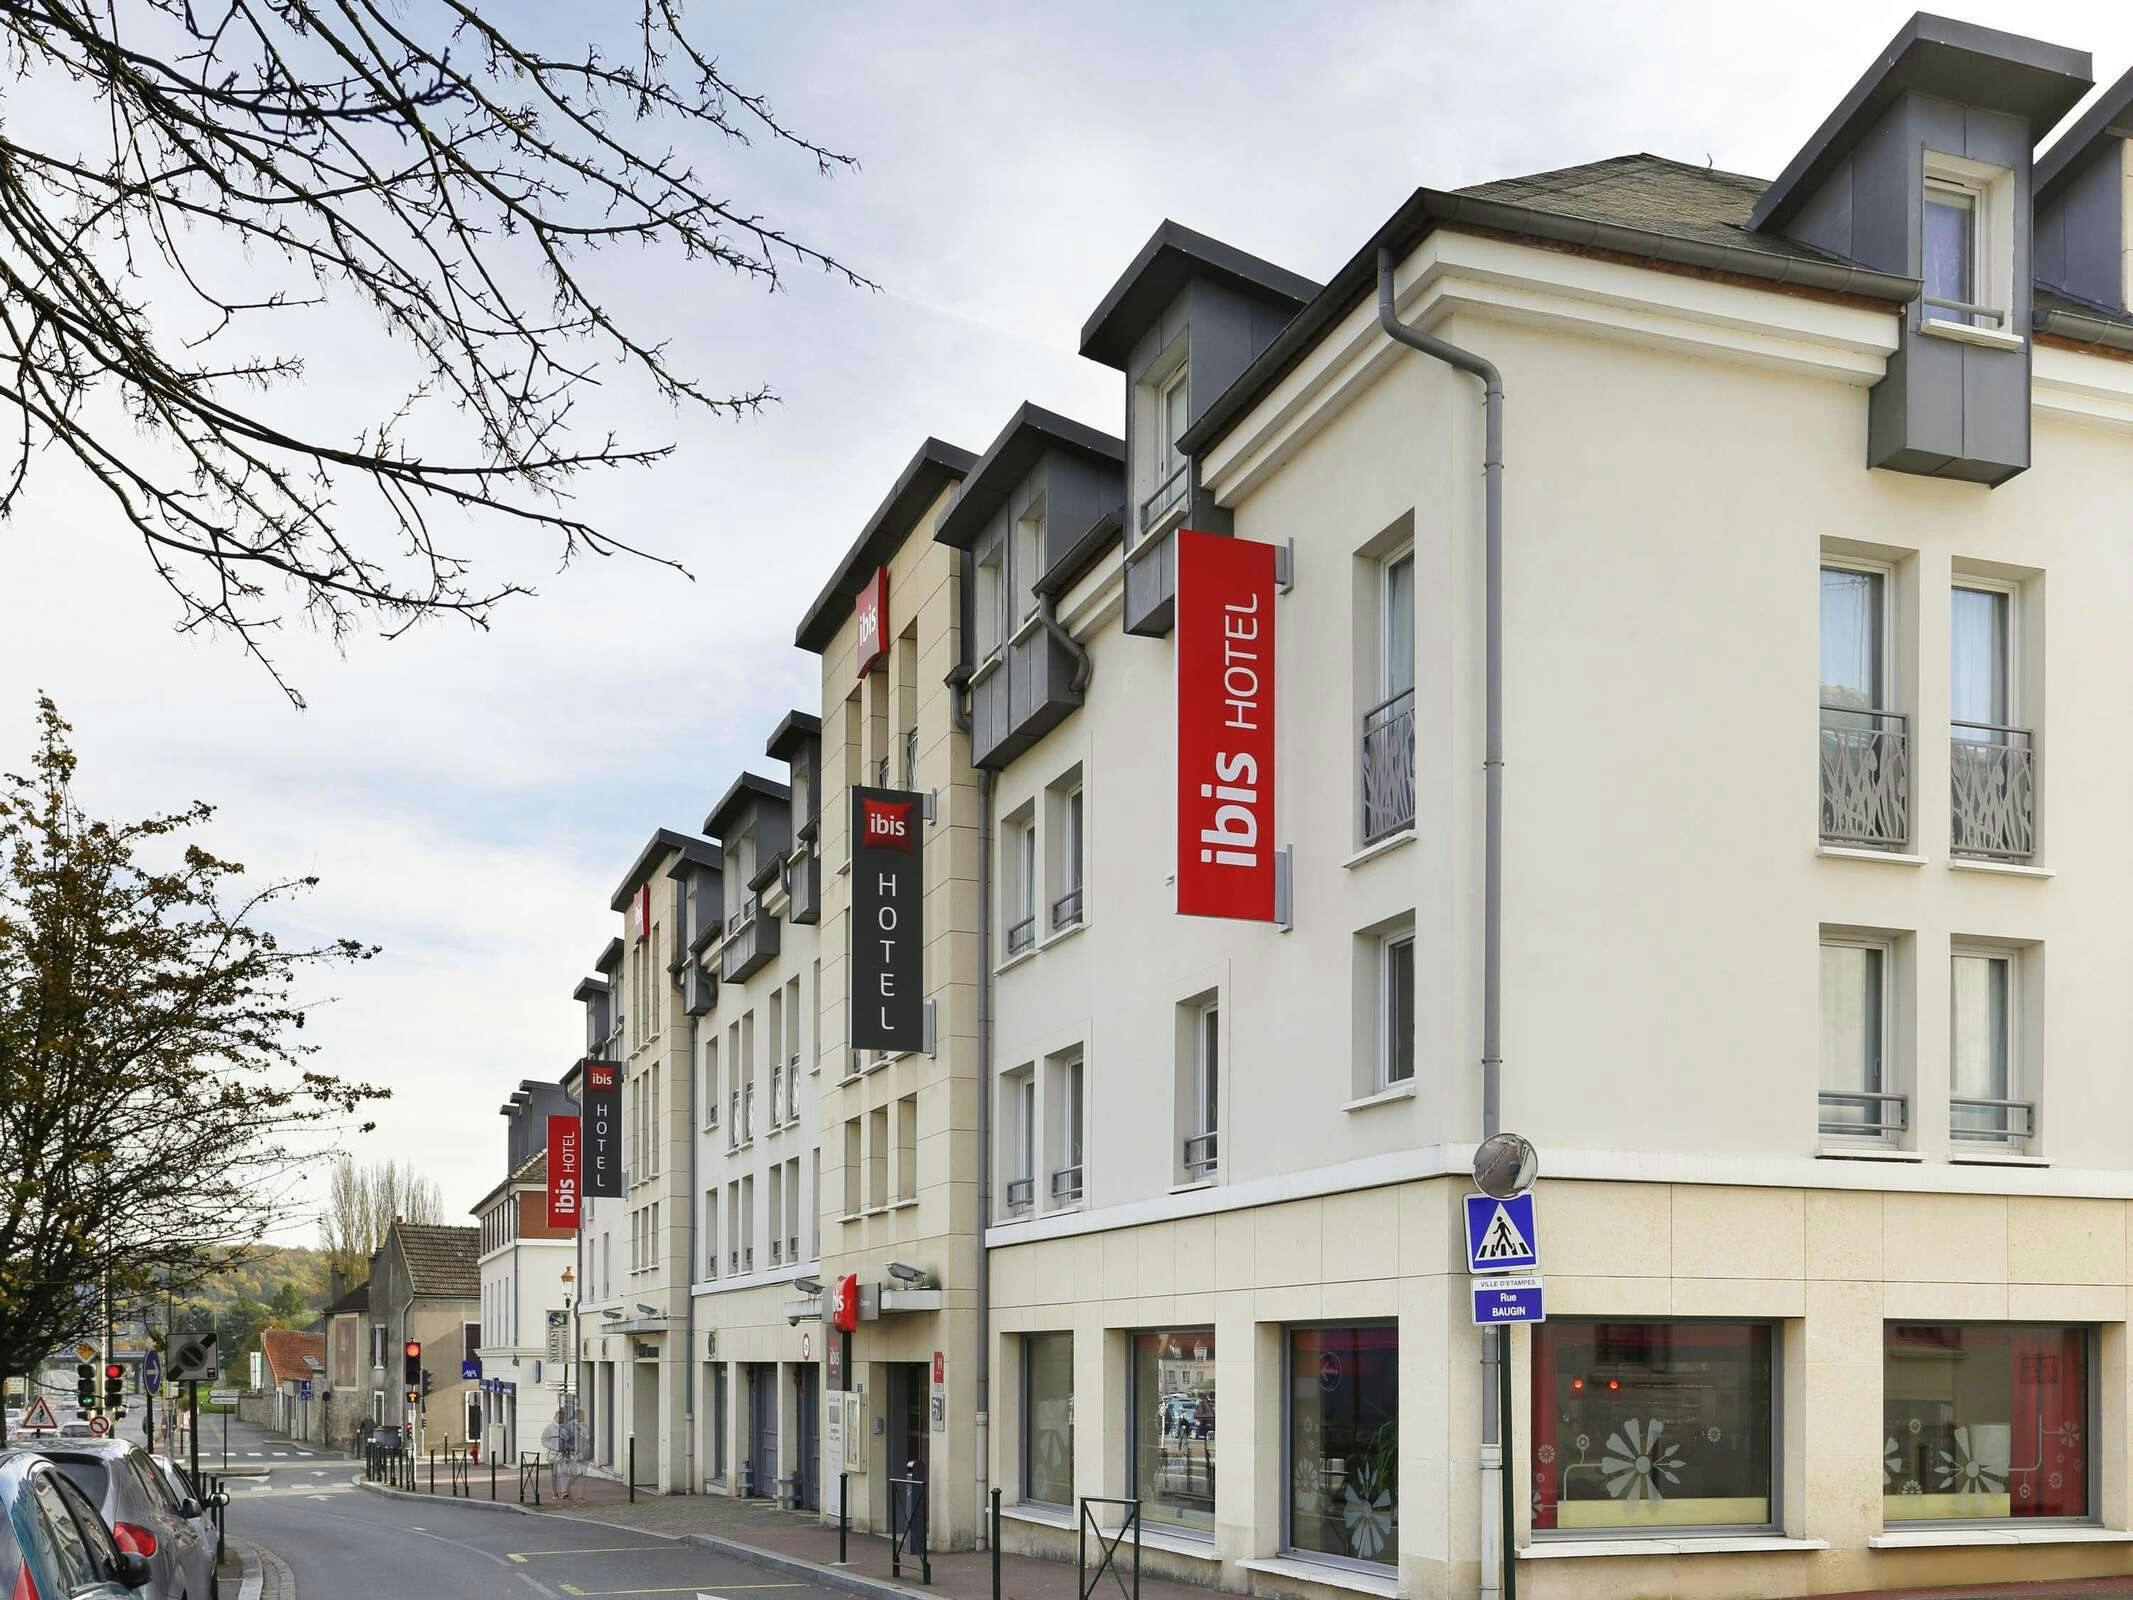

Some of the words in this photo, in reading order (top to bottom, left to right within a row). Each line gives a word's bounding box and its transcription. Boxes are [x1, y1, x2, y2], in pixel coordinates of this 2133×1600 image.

[859, 604, 876, 647] ibis
[1224, 592, 1258, 730] HOTEL
[870, 813, 905, 836] ibis
[1201, 752, 1258, 867] ibis
[878, 873, 897, 1030] HOTEL
[592, 1073, 612, 1085] ibis
[562, 1131, 575, 1173] HOTEL
[596, 1104, 607, 1187] HOTEL
[555, 1178, 575, 1214] ibis
[1492, 1306, 1526, 1317] BAUGIN
[1500, 1293, 1517, 1302] Rue
[463, 1369, 477, 1377] AXA
